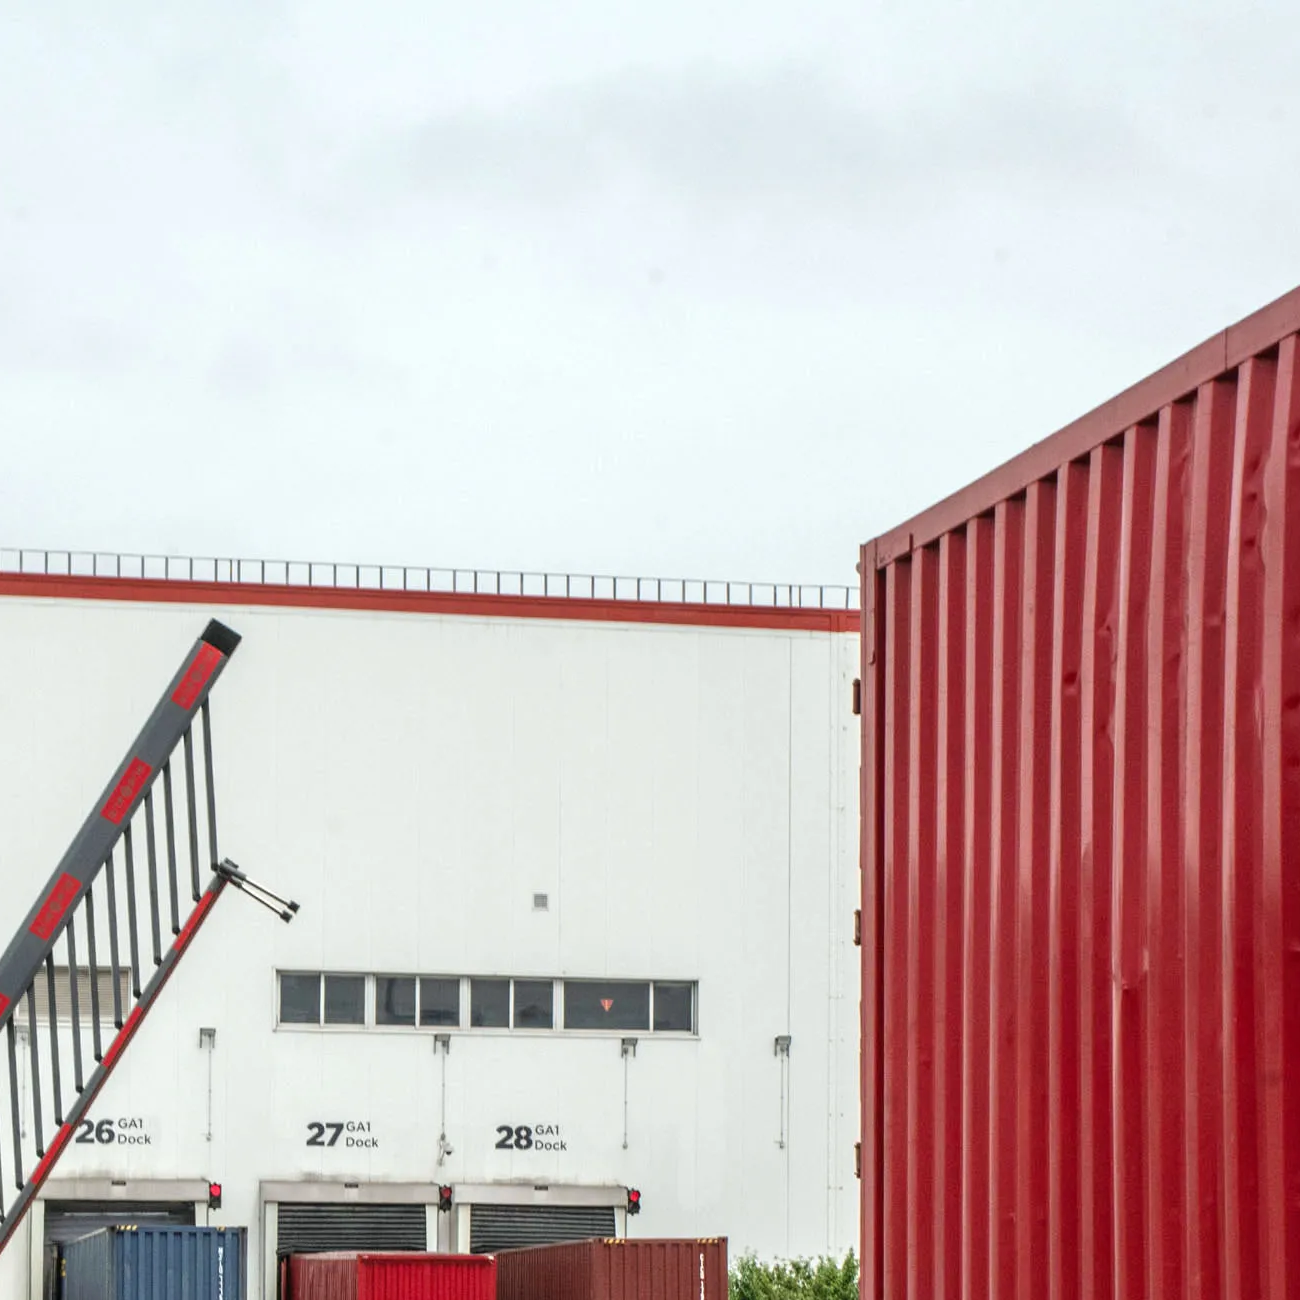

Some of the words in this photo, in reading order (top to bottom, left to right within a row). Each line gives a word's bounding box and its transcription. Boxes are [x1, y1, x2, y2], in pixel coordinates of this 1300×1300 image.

[75, 1119, 115, 1144] 26
[118, 1118, 143, 1129] GA1
[118, 1133, 151, 1145] Dock
[306, 1122, 344, 1147] 27
[346, 1121, 371, 1133] GA1
[495, 1125, 532, 1150] 28
[535, 1125, 560, 1136] GA1
[345, 1137, 379, 1148] Dock
[534, 1140, 567, 1151] Dock
